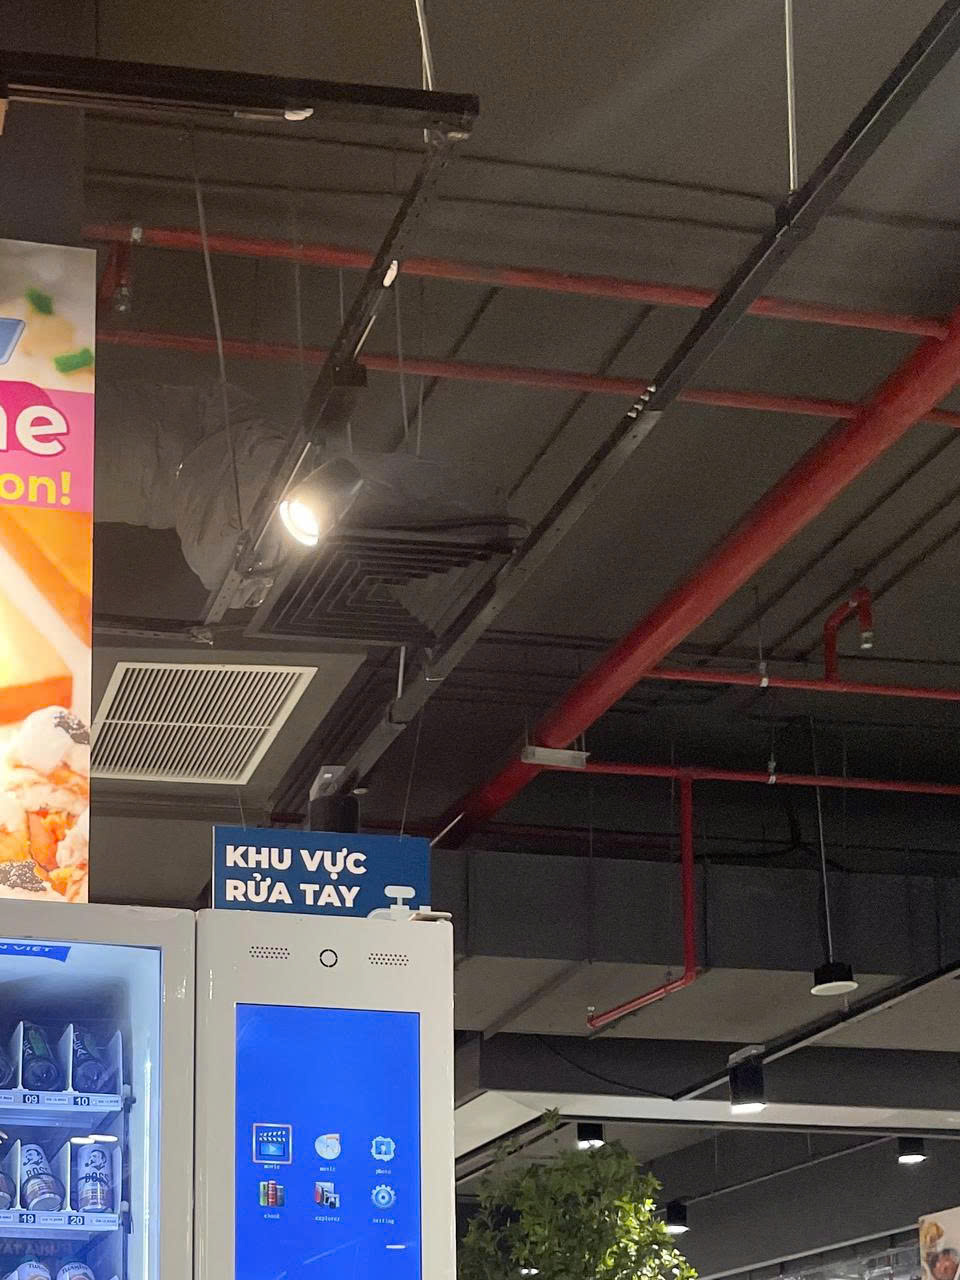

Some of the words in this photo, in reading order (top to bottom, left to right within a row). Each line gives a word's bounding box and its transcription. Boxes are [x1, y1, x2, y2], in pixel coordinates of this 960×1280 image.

[225, 845, 292, 871] KHU
[300, 847, 368, 881] VỰC
[225, 872, 293, 905] RỬA
[299, 883, 361, 908] TAY
[25, 1095, 39, 1104] 09
[75, 1097, 88, 1106] 10
[84, 1172, 111, 1184] BOSS
[20, 1214, 34, 1223] 19
[70, 1216, 83, 1225] 20
